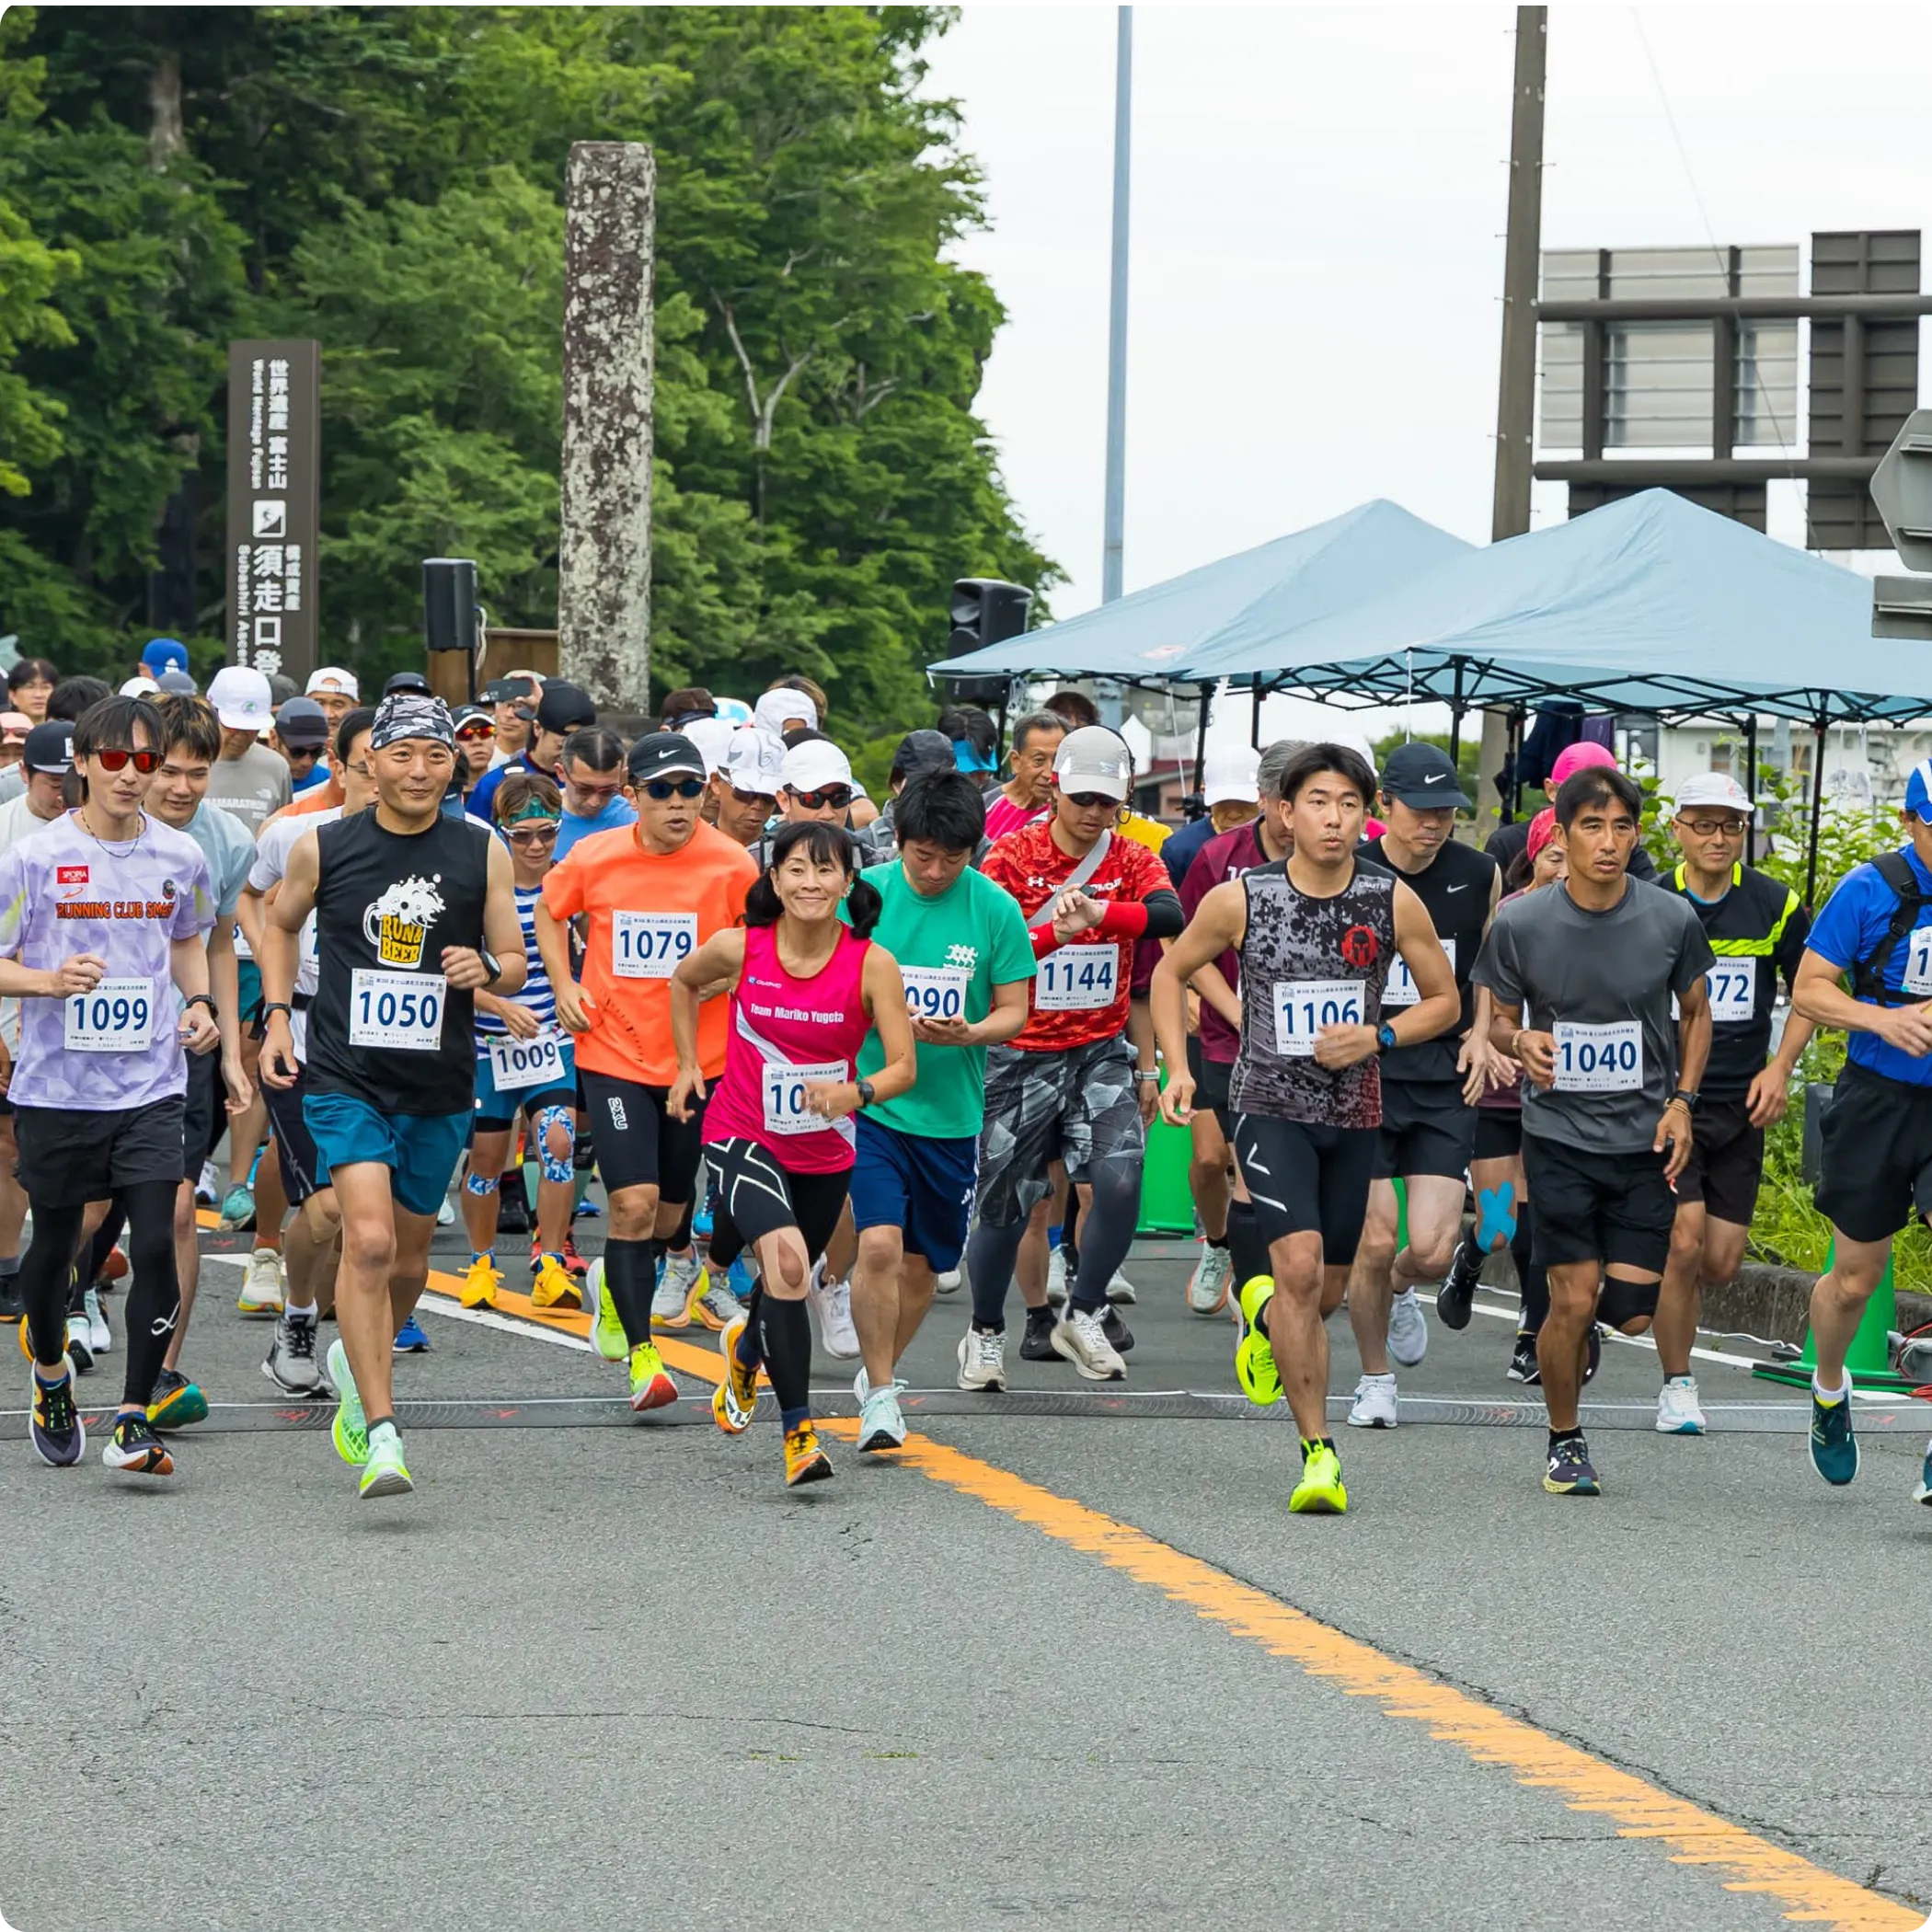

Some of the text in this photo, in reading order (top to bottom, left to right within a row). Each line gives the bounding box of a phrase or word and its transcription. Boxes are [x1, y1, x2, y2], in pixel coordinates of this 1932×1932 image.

[268, 436, 288, 489] 富士山
[236, 545, 251, 666] Subashiri Ascen
[57, 903, 110, 919] RUNNING
[113, 901, 144, 918] CLUB
[382, 914, 423, 943] RUN&
[620, 930, 692, 960] 1079
[381, 939, 420, 963] BEER
[1044, 961, 1113, 992] 1144
[1706, 974, 1749, 1002] 72
[74, 997, 148, 1031] 1099
[359, 991, 438, 1029] 1050
[751, 1003, 845, 1024] Team Mariko Yugeta
[904, 985, 960, 1018] 090
[1282, 998, 1360, 1034] 1106
[497, 1041, 556, 1074] 1009
[1560, 1040, 1637, 1073] 1040
[607, 1096, 628, 1130] 2XU
[771, 1084, 806, 1115] 10
